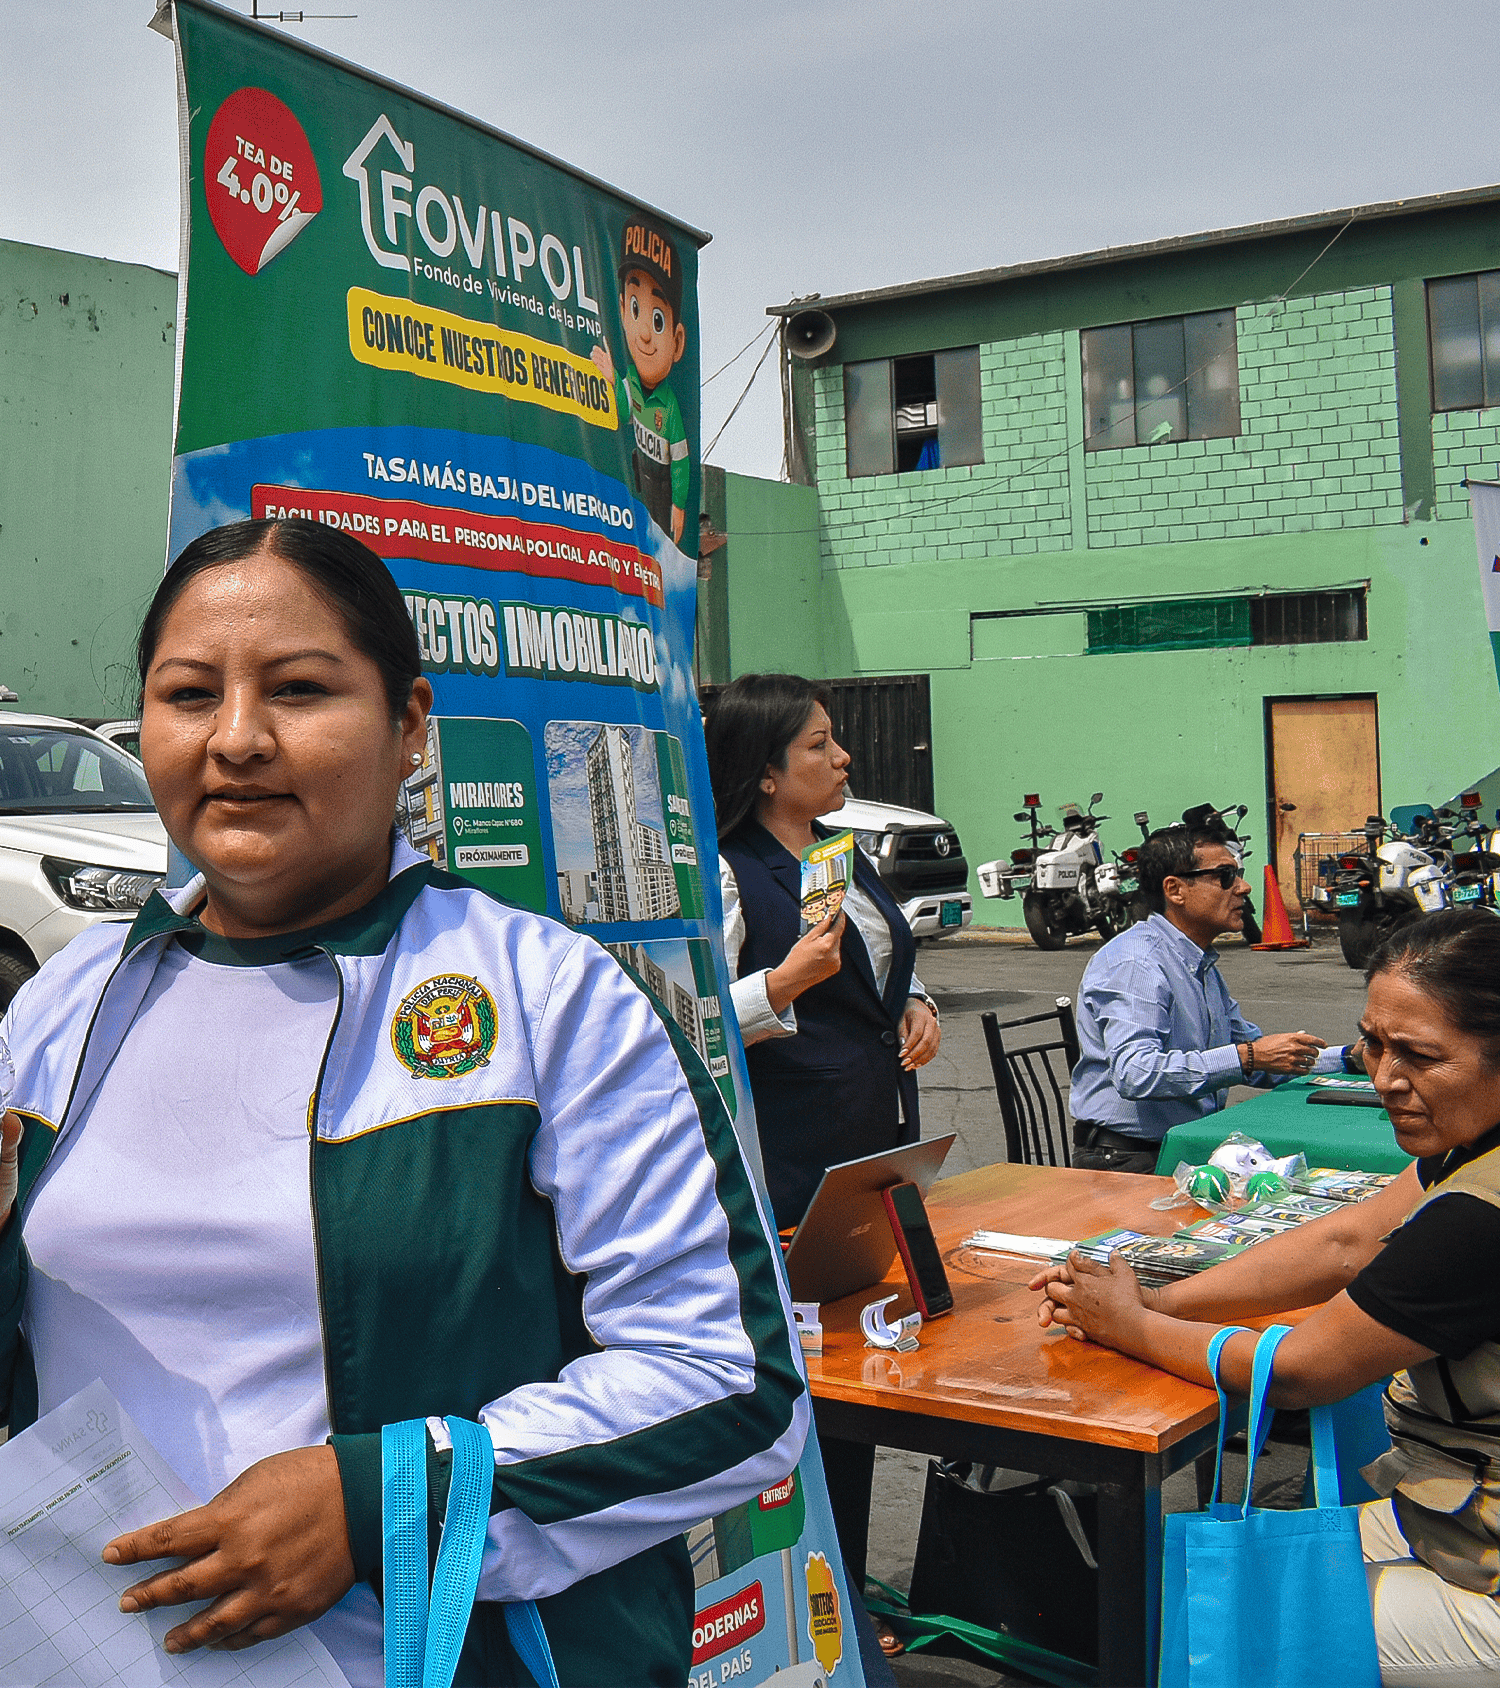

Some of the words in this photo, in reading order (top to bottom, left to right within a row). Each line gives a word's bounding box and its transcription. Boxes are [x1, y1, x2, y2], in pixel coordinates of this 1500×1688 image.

[236, 134, 265, 169] TEA
[270, 154, 293, 181] DE
[217, 156, 301, 221] 4.0%
[381, 170, 599, 315] FOVIPOL
[625, 225, 671, 278] POLICIA
[414, 257, 460, 289] Fondo
[463, 275, 483, 295] de
[487, 278, 544, 316] Vivienda
[548, 302, 562, 323] de
[563, 308, 574, 329] la
[577, 316, 602, 338] PNP
[362, 306, 437, 363] CONOCE
[441, 327, 528, 386] NUESTROS
[531, 352, 610, 413] BENEFICIOS
[363, 452, 420, 485] TASA
[423, 461, 467, 493] MÁS
[469, 472, 519, 503] BAJA
[522, 482, 561, 511] DEL
[384, 518, 429, 541] PARA
[431, 524, 451, 544] EL
[527, 539, 585, 564] POLICIAL
[623, 559, 631, 577] Y
[404, 595, 498, 667] ECTOS
[449, 782, 524, 808] MIRAFLORES
[1057, 870, 1077, 879] POLICIA
[400, 985, 431, 1017] POLICIA
[433, 976, 482, 997] NACIONAL
[691, 1598, 759, 1649] ODERNAS
[721, 1648, 752, 1683] PAÍS
